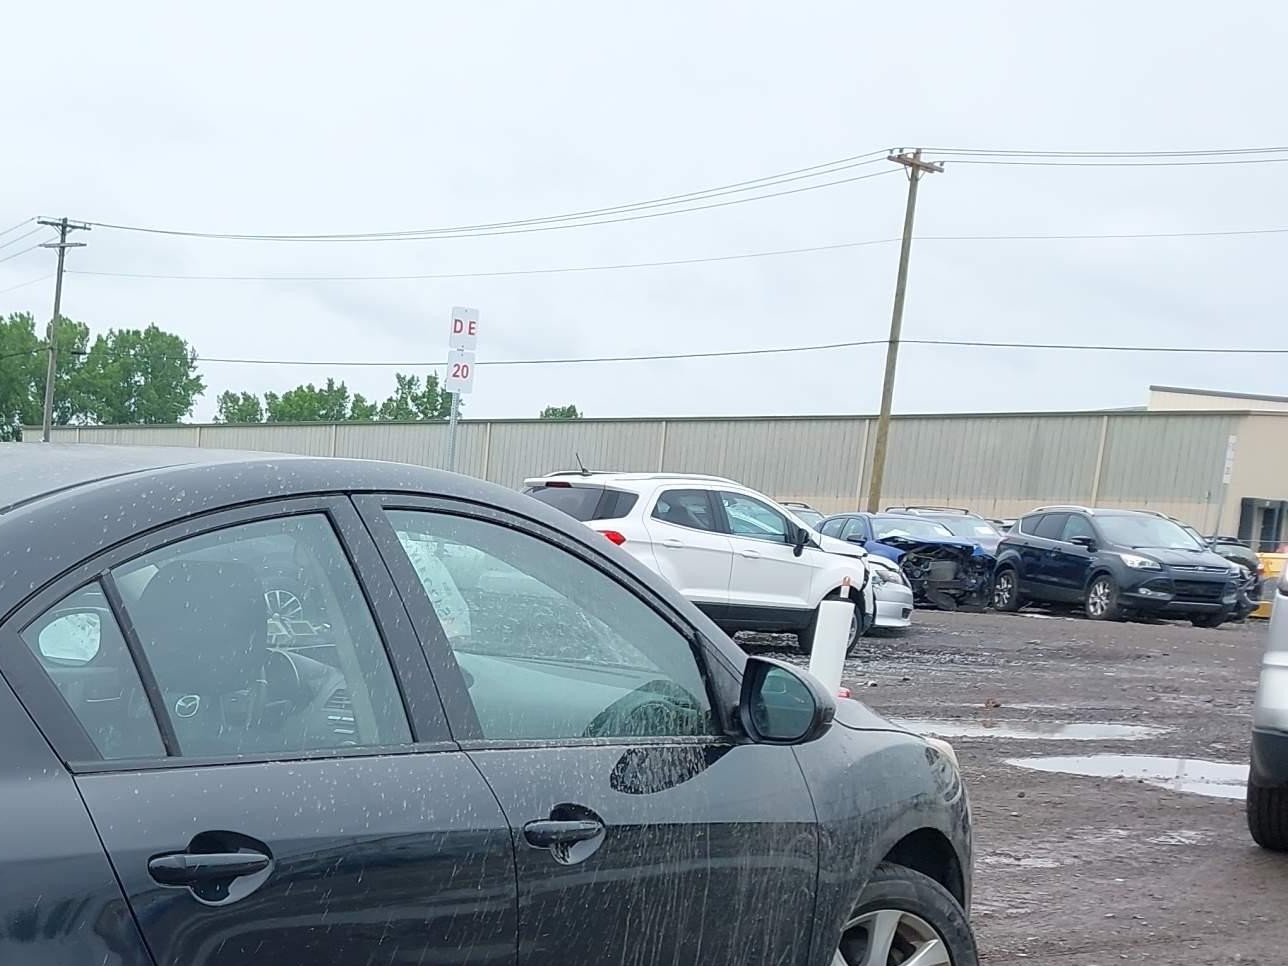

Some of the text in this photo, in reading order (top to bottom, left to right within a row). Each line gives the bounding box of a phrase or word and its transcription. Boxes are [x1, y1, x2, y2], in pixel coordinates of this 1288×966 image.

[453, 319, 477, 336] D E
[452, 363, 469, 379] 20
